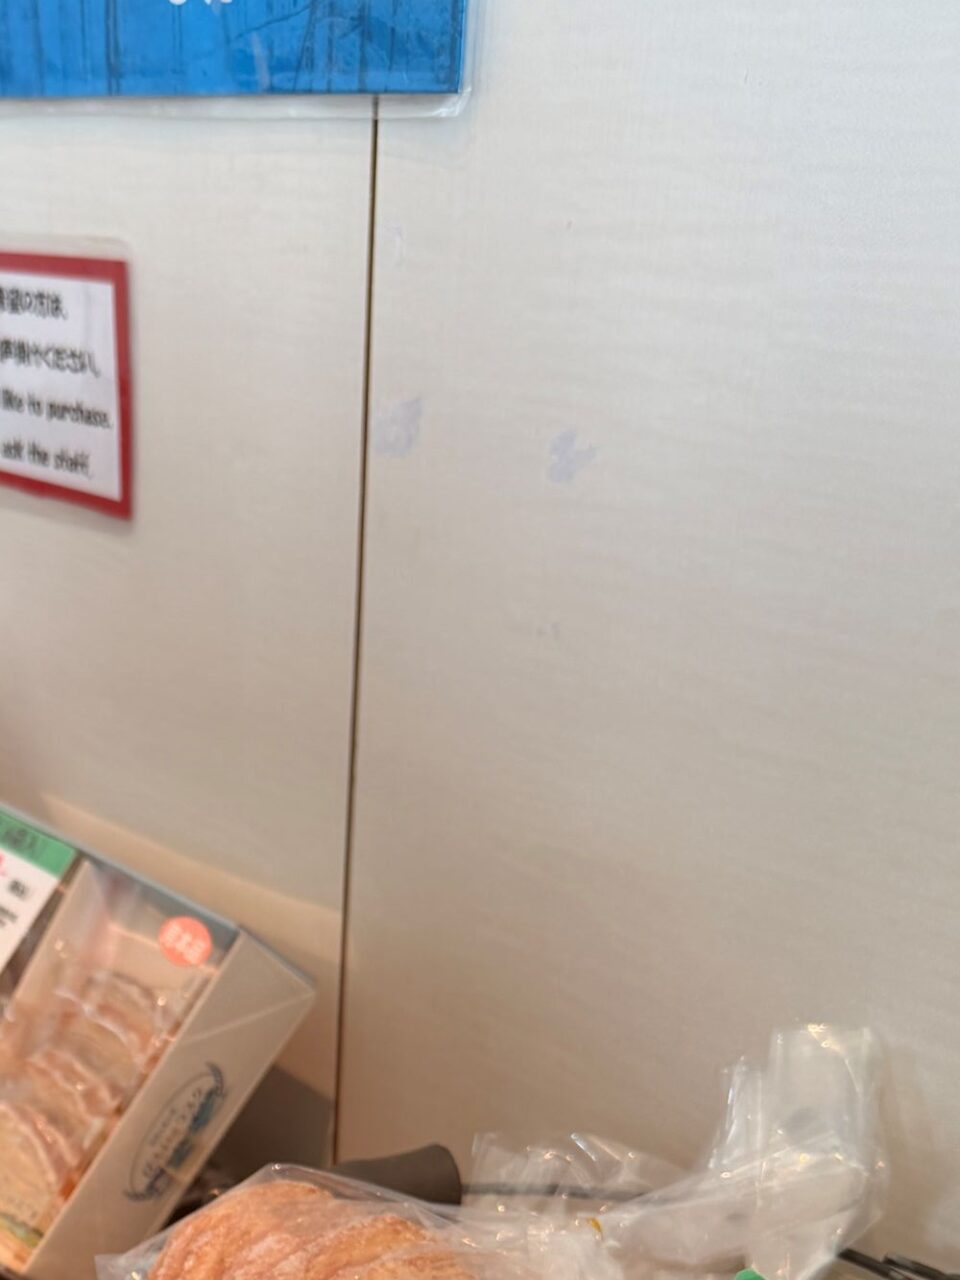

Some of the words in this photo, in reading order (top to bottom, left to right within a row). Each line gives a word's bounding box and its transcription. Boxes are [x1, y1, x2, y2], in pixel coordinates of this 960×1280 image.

[1, 388, 25, 412] like
[27, 393, 44, 416] to
[1, 437, 25, 461] ask
[28, 440, 50, 466] the
